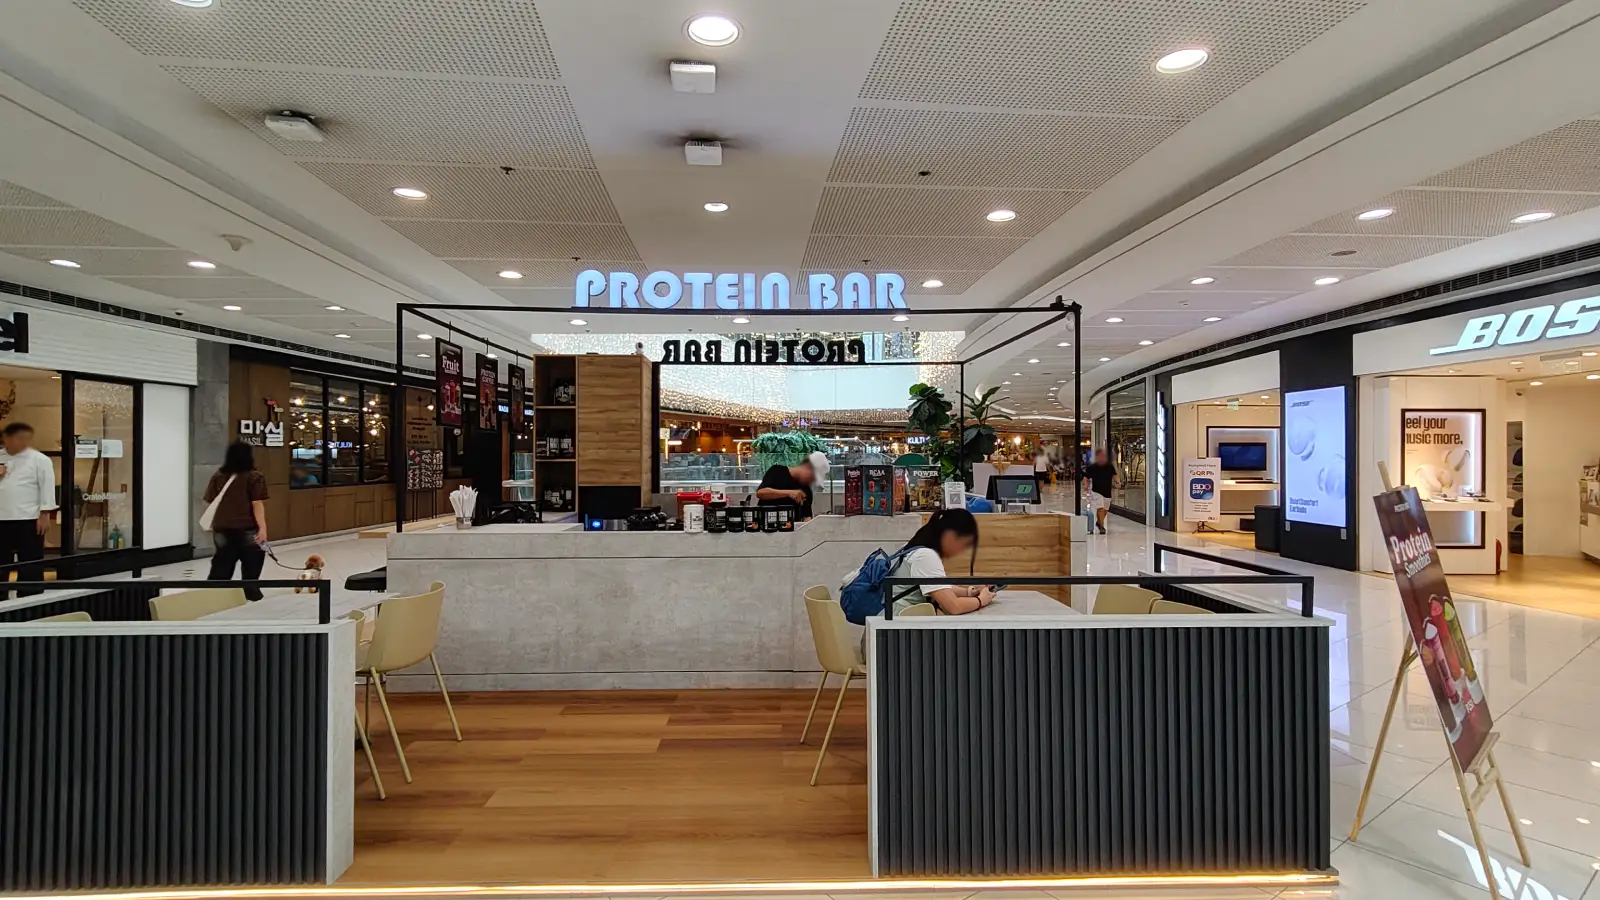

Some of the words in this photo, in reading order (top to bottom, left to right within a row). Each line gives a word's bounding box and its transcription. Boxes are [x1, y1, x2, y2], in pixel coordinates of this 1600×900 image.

[575, 269, 791, 309] PROTEIN
[808, 272, 907, 310] BAR
[1429, 295, 1600, 355] BOS
[442, 355, 460, 374] Fruit
[240, 419, 284, 447] 마실
[1423, 417, 1447, 431] your
[1433, 433, 1463, 445] more.
[1389, 526, 1432, 565] Protein
[1404, 552, 1432, 578] Smoothies
